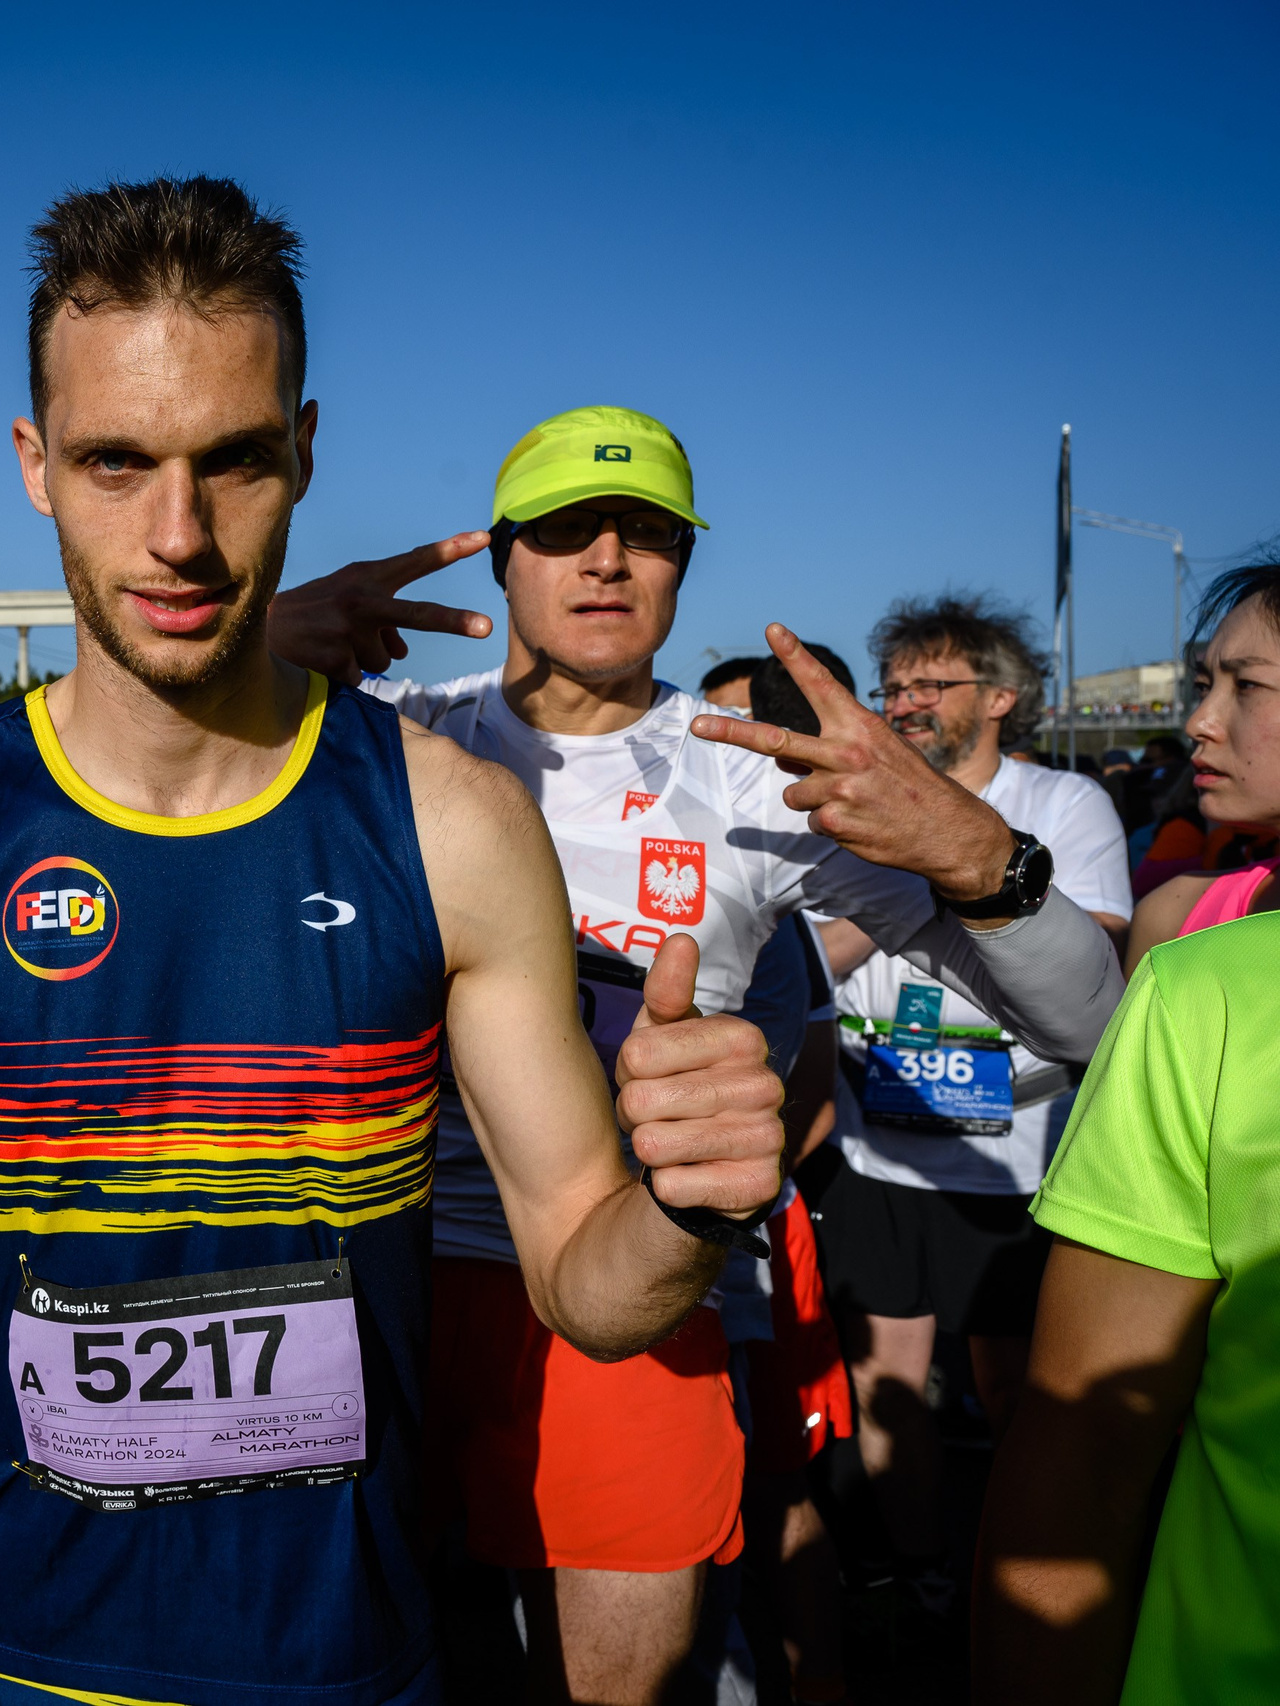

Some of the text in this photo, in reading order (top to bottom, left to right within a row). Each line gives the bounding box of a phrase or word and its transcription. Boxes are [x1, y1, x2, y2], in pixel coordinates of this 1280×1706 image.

[645, 841, 702, 857] POLSKA
[571, 912, 667, 959] KA
[895, 1050, 975, 1084] 396
[54, 1300, 110, 1317] Kaspi.kz
[73, 1314, 287, 1404] 5217
[20, 1361, 46, 1396] A
[47, 1404, 68, 1415] IBAI
[236, 1412, 323, 1426] VIRTUS 10 KM
[51, 1432, 158, 1448] ALMATY HALF
[211, 1427, 297, 1442] ALMATY
[53, 1443, 187, 1460] MARATHON 2024
[240, 1434, 360, 1454] MARATHON
[82, 1484, 135, 1497] Музыка
[158, 1494, 193, 1503] KRIDA
